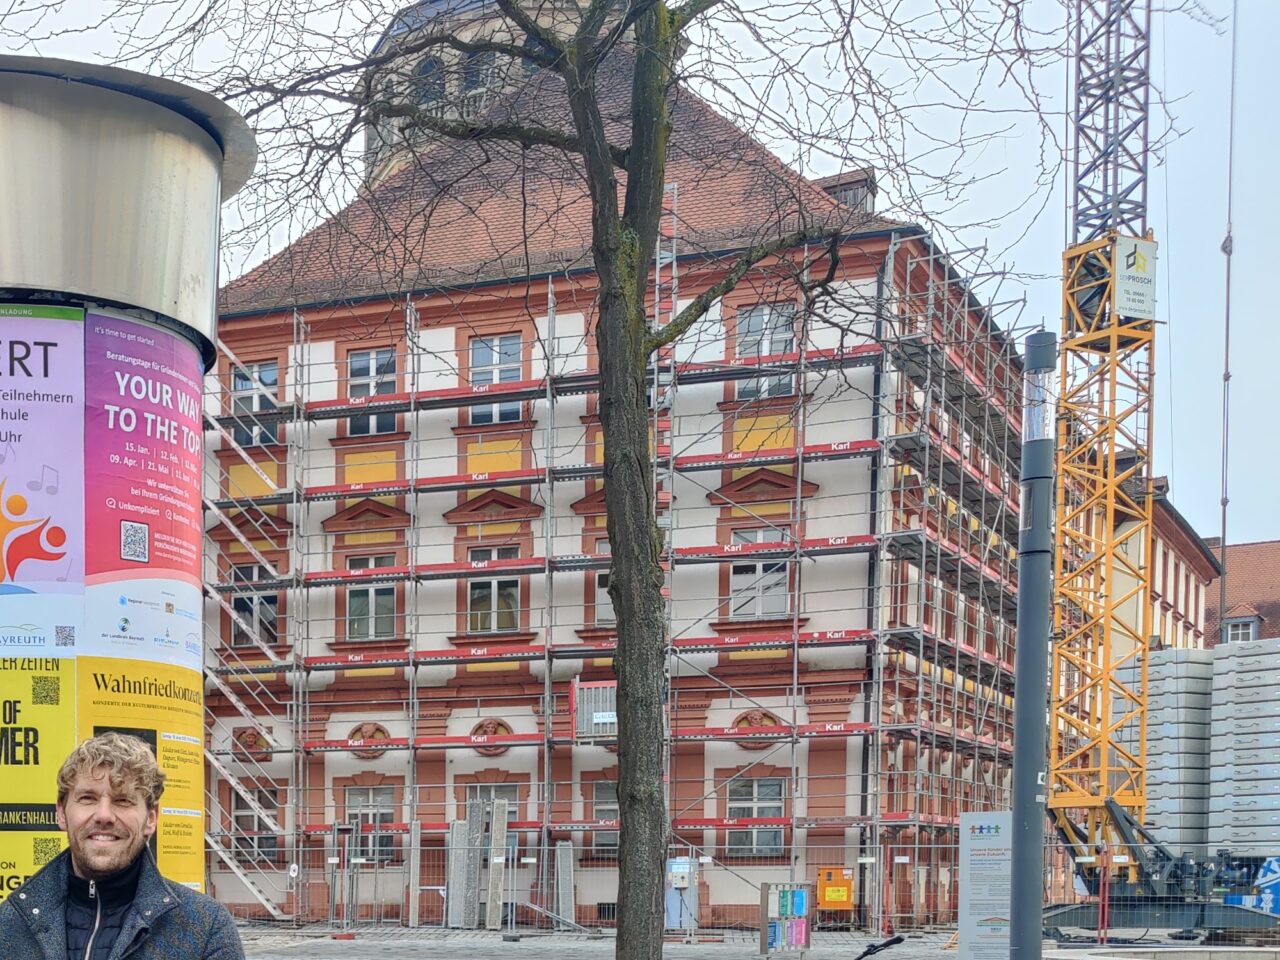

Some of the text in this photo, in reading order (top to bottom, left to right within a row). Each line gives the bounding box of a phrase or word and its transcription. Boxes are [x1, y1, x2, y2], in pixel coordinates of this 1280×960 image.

[105, 328, 120, 338] time
[120, 331, 127, 339] to
[106, 350, 161, 371] Beratungstage für
[730, 358, 745, 366] Karl
[472, 384, 489, 392] Karl
[114, 371, 174, 409] YOUR
[177, 389, 200, 424] WAY
[349, 396, 365, 404] Karl
[104, 404, 137, 432] TO
[144, 412, 179, 445] THE
[125, 442, 137, 452] 15.
[831, 442, 850, 451] Karl
[110, 454, 122, 464] 09.
[123, 457, 138, 468] Apr.
[472, 472, 488, 480] Karl
[131, 487, 141, 496] bei
[119, 501, 160, 516] Unkompliziert
[828, 537, 848, 545] Karl
[723, 544, 742, 552] Karl
[471, 560, 488, 568] Karl
[826, 631, 846, 639] Karl
[471, 647, 487, 655] Karl
[348, 653, 364, 662] Karl
[20, 658, 60, 672] ZEITEN
[2, 700, 21, 725] OF
[825, 723, 844, 731] Karl
[348, 738, 364, 746] Karl
[471, 734, 487, 743] Karl
[599, 819, 616, 827] Karl
